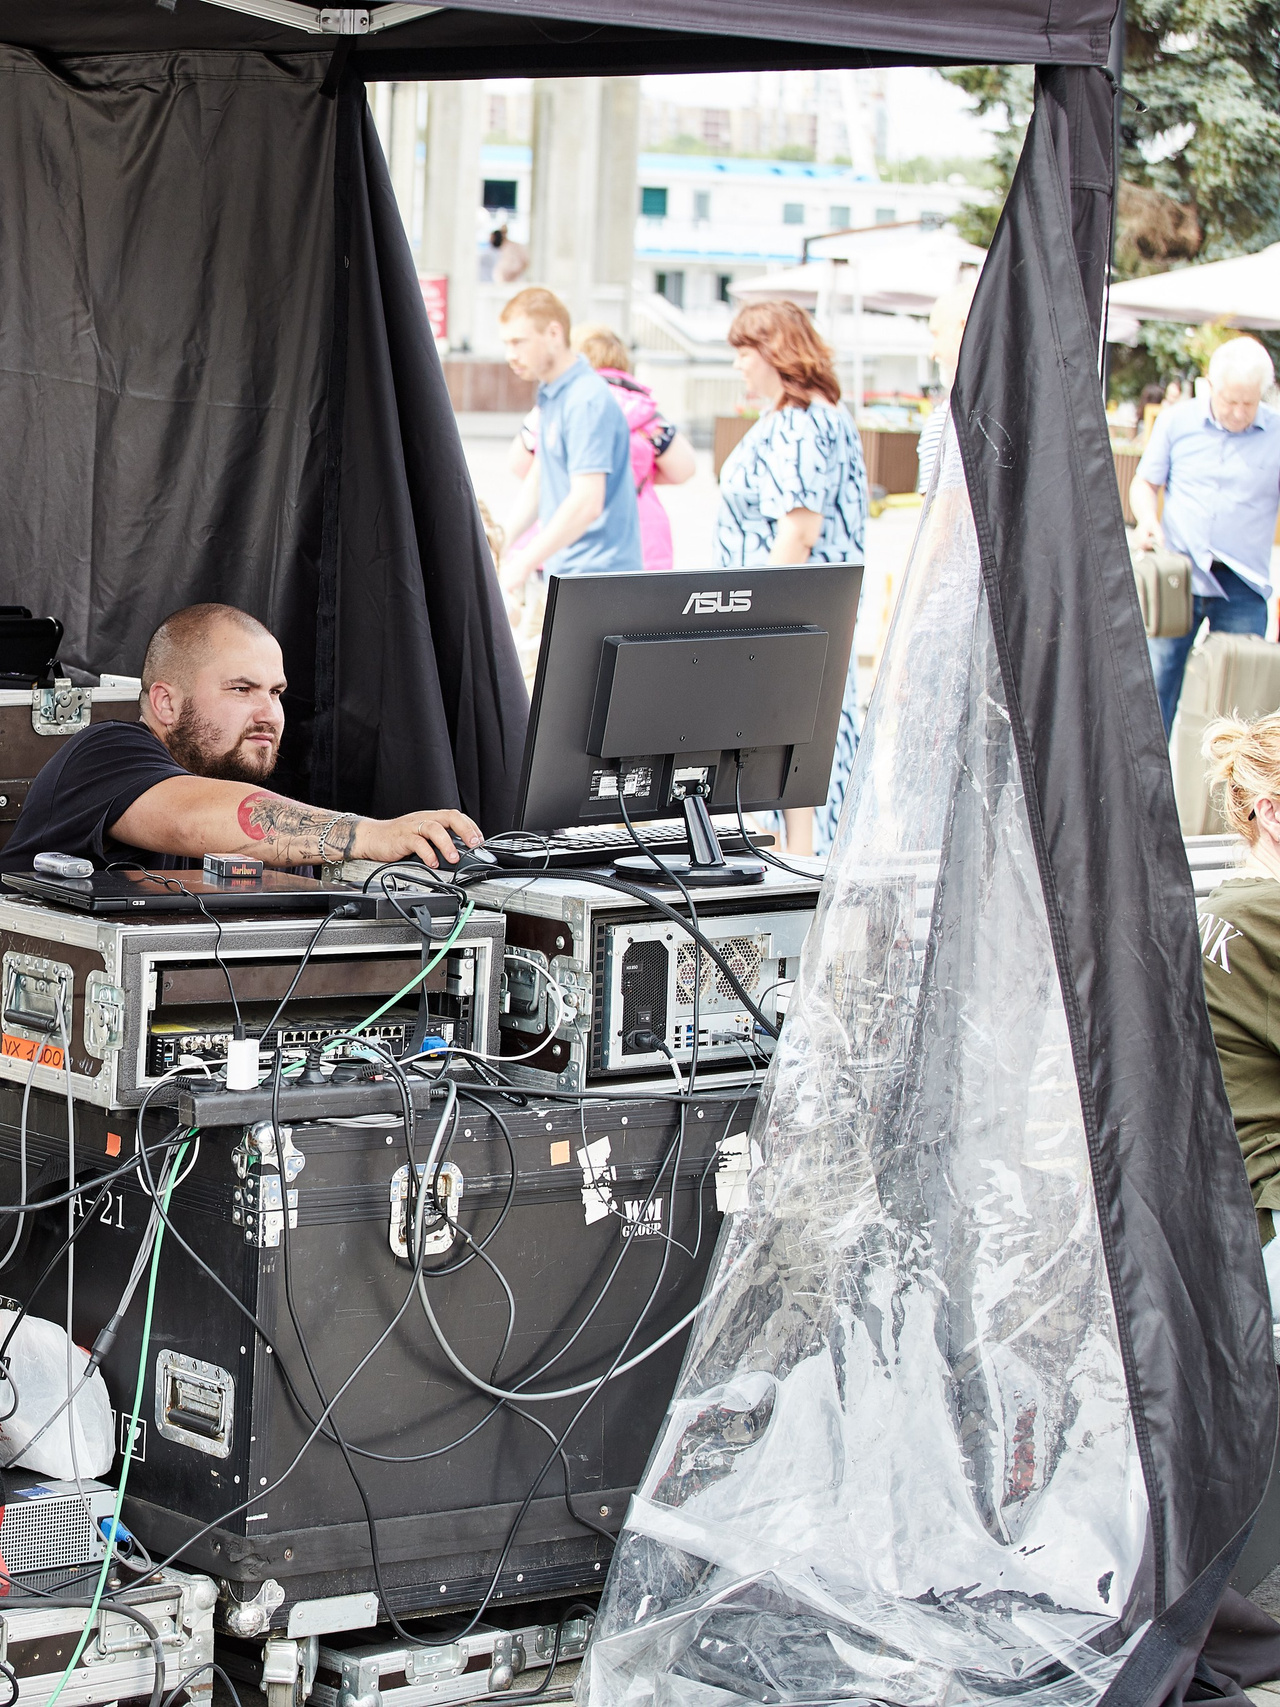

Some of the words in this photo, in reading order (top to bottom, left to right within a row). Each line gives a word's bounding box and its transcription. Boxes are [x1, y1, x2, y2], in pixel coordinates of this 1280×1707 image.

[681, 589, 752, 614] ASUS
[231, 863, 257, 875] Marlboro
[4, 1038, 21, 1057] VX
[623, 1198, 663, 1223] WM
